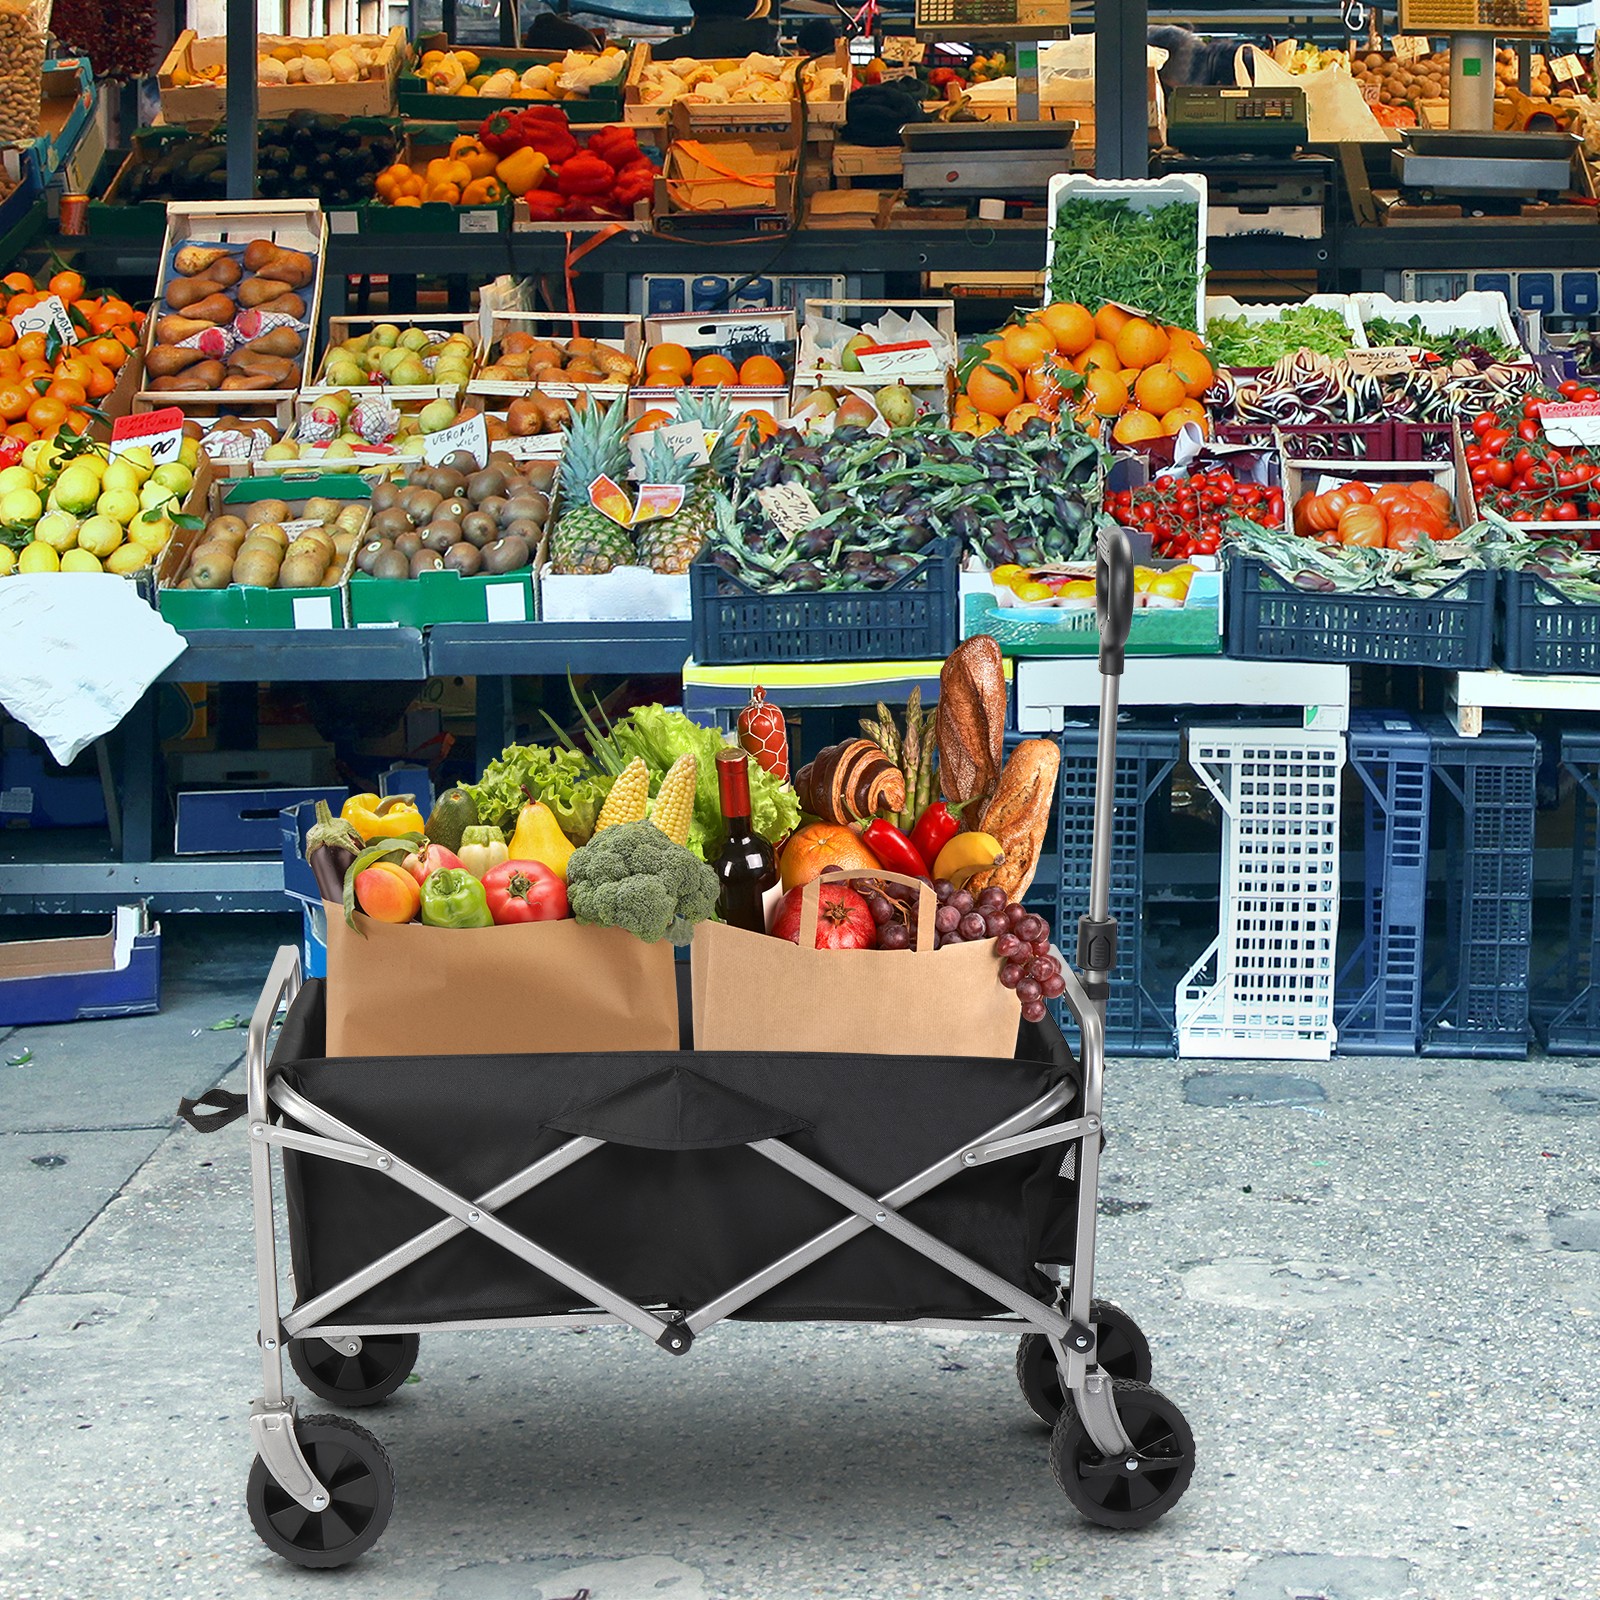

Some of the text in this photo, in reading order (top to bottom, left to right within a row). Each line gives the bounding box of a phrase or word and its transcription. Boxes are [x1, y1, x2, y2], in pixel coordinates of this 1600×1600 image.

[432, 422, 474, 446] VERONA
[456, 434, 480, 447] KILO
[667, 435, 692, 445] KILO
